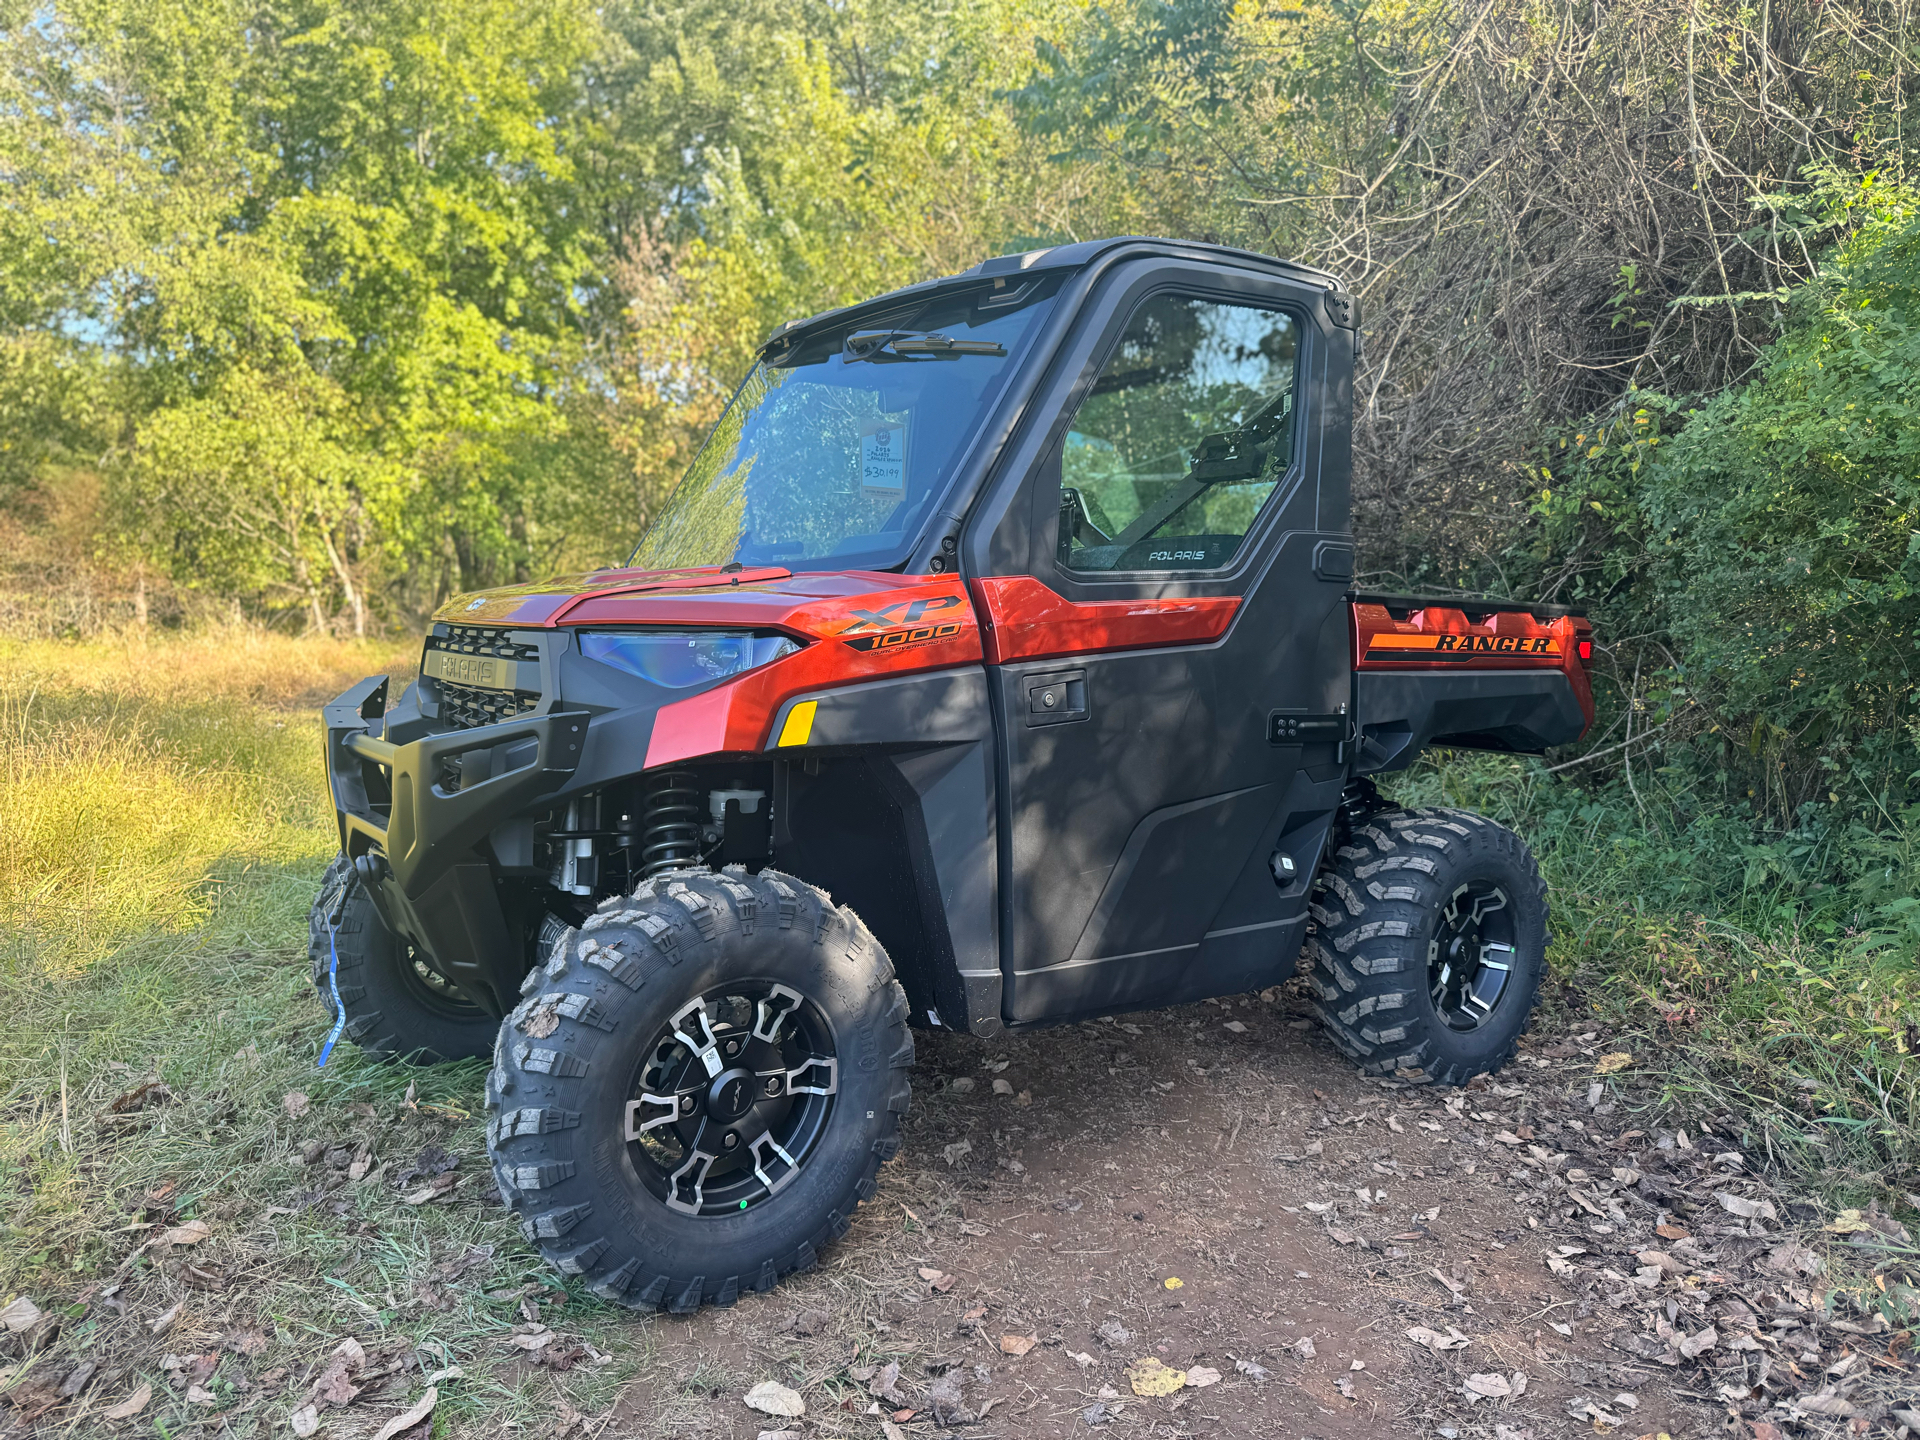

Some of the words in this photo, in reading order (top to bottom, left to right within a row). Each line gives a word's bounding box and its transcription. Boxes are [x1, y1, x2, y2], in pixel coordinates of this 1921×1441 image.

[1148, 550, 1205, 561] POLARIS
[835, 595, 962, 635] XP
[871, 622, 961, 649] 1000
[1434, 634, 1550, 653] RANGER
[440, 655, 493, 683] POLARIS
